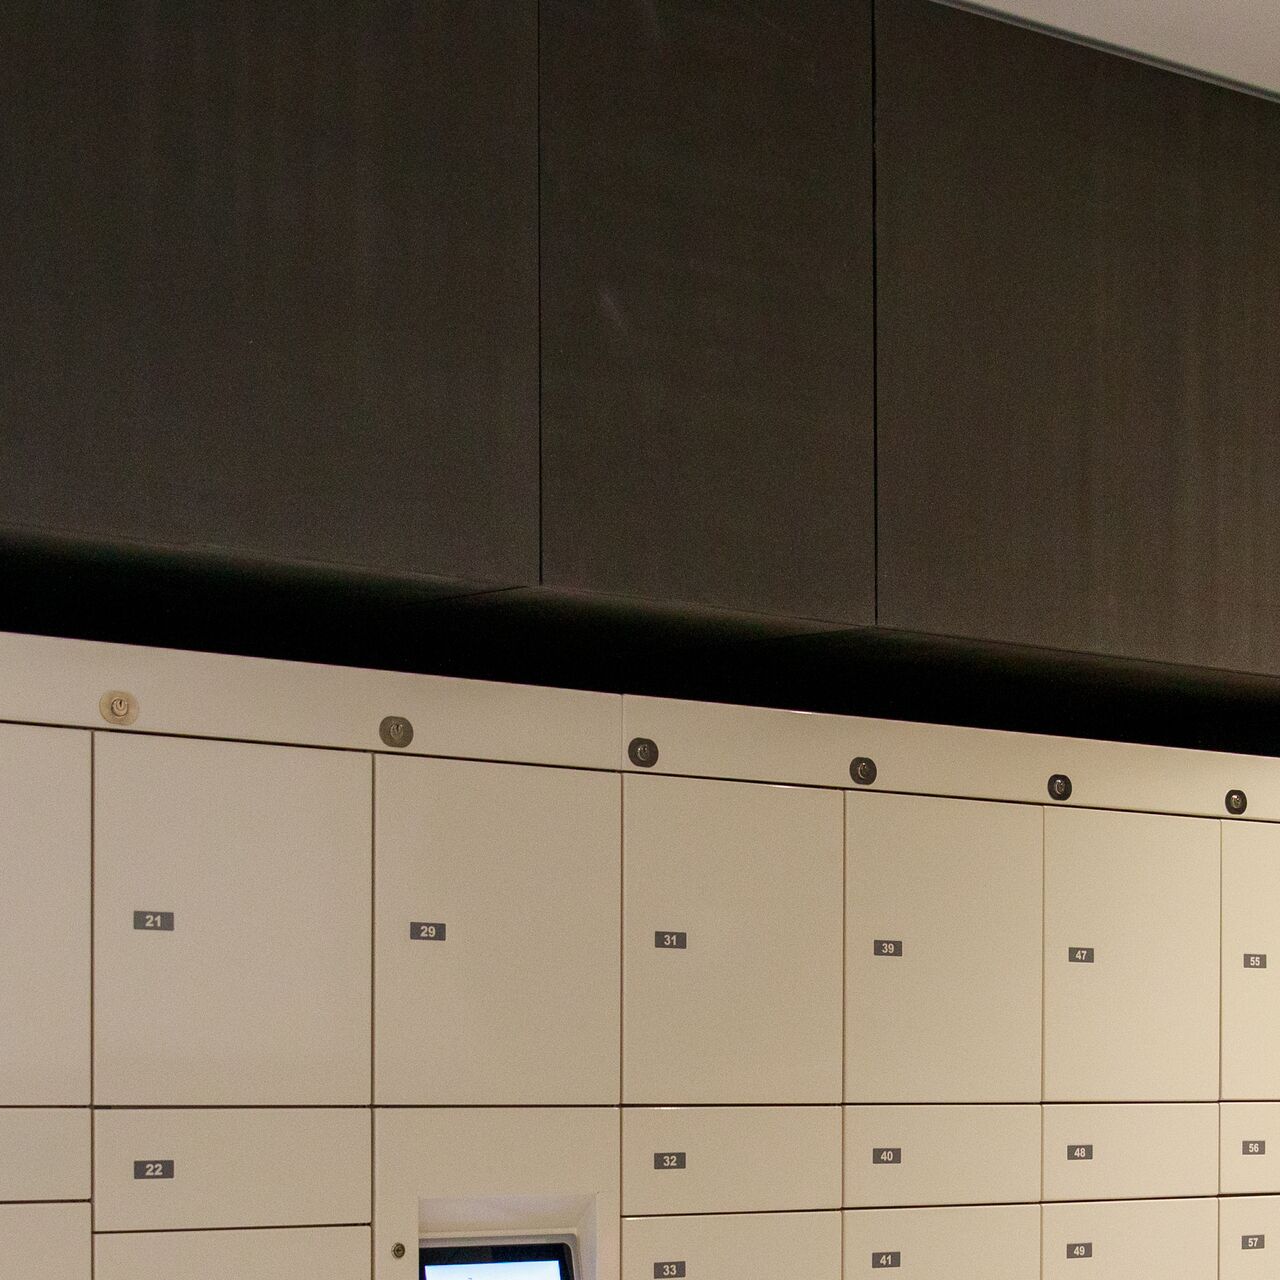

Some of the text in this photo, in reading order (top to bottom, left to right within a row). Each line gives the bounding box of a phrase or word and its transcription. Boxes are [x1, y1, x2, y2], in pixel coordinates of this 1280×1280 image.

[145, 915, 161, 927] 21
[420, 925, 436, 938] 29
[664, 934, 676, 946] 31
[882, 943, 894, 954] 39
[1075, 950, 1087, 960] 47
[1250, 956, 1260, 966] 55
[1074, 1147, 1086, 1158] 48
[1248, 1143, 1259, 1153] 56
[663, 1155, 677, 1166] 32
[880, 1151, 893, 1161] 40
[145, 1163, 163, 1176] 22
[1248, 1237, 1258, 1247] 57
[1073, 1246, 1085, 1256] 49
[880, 1254, 891, 1265] 41
[663, 1264, 677, 1276] 33
